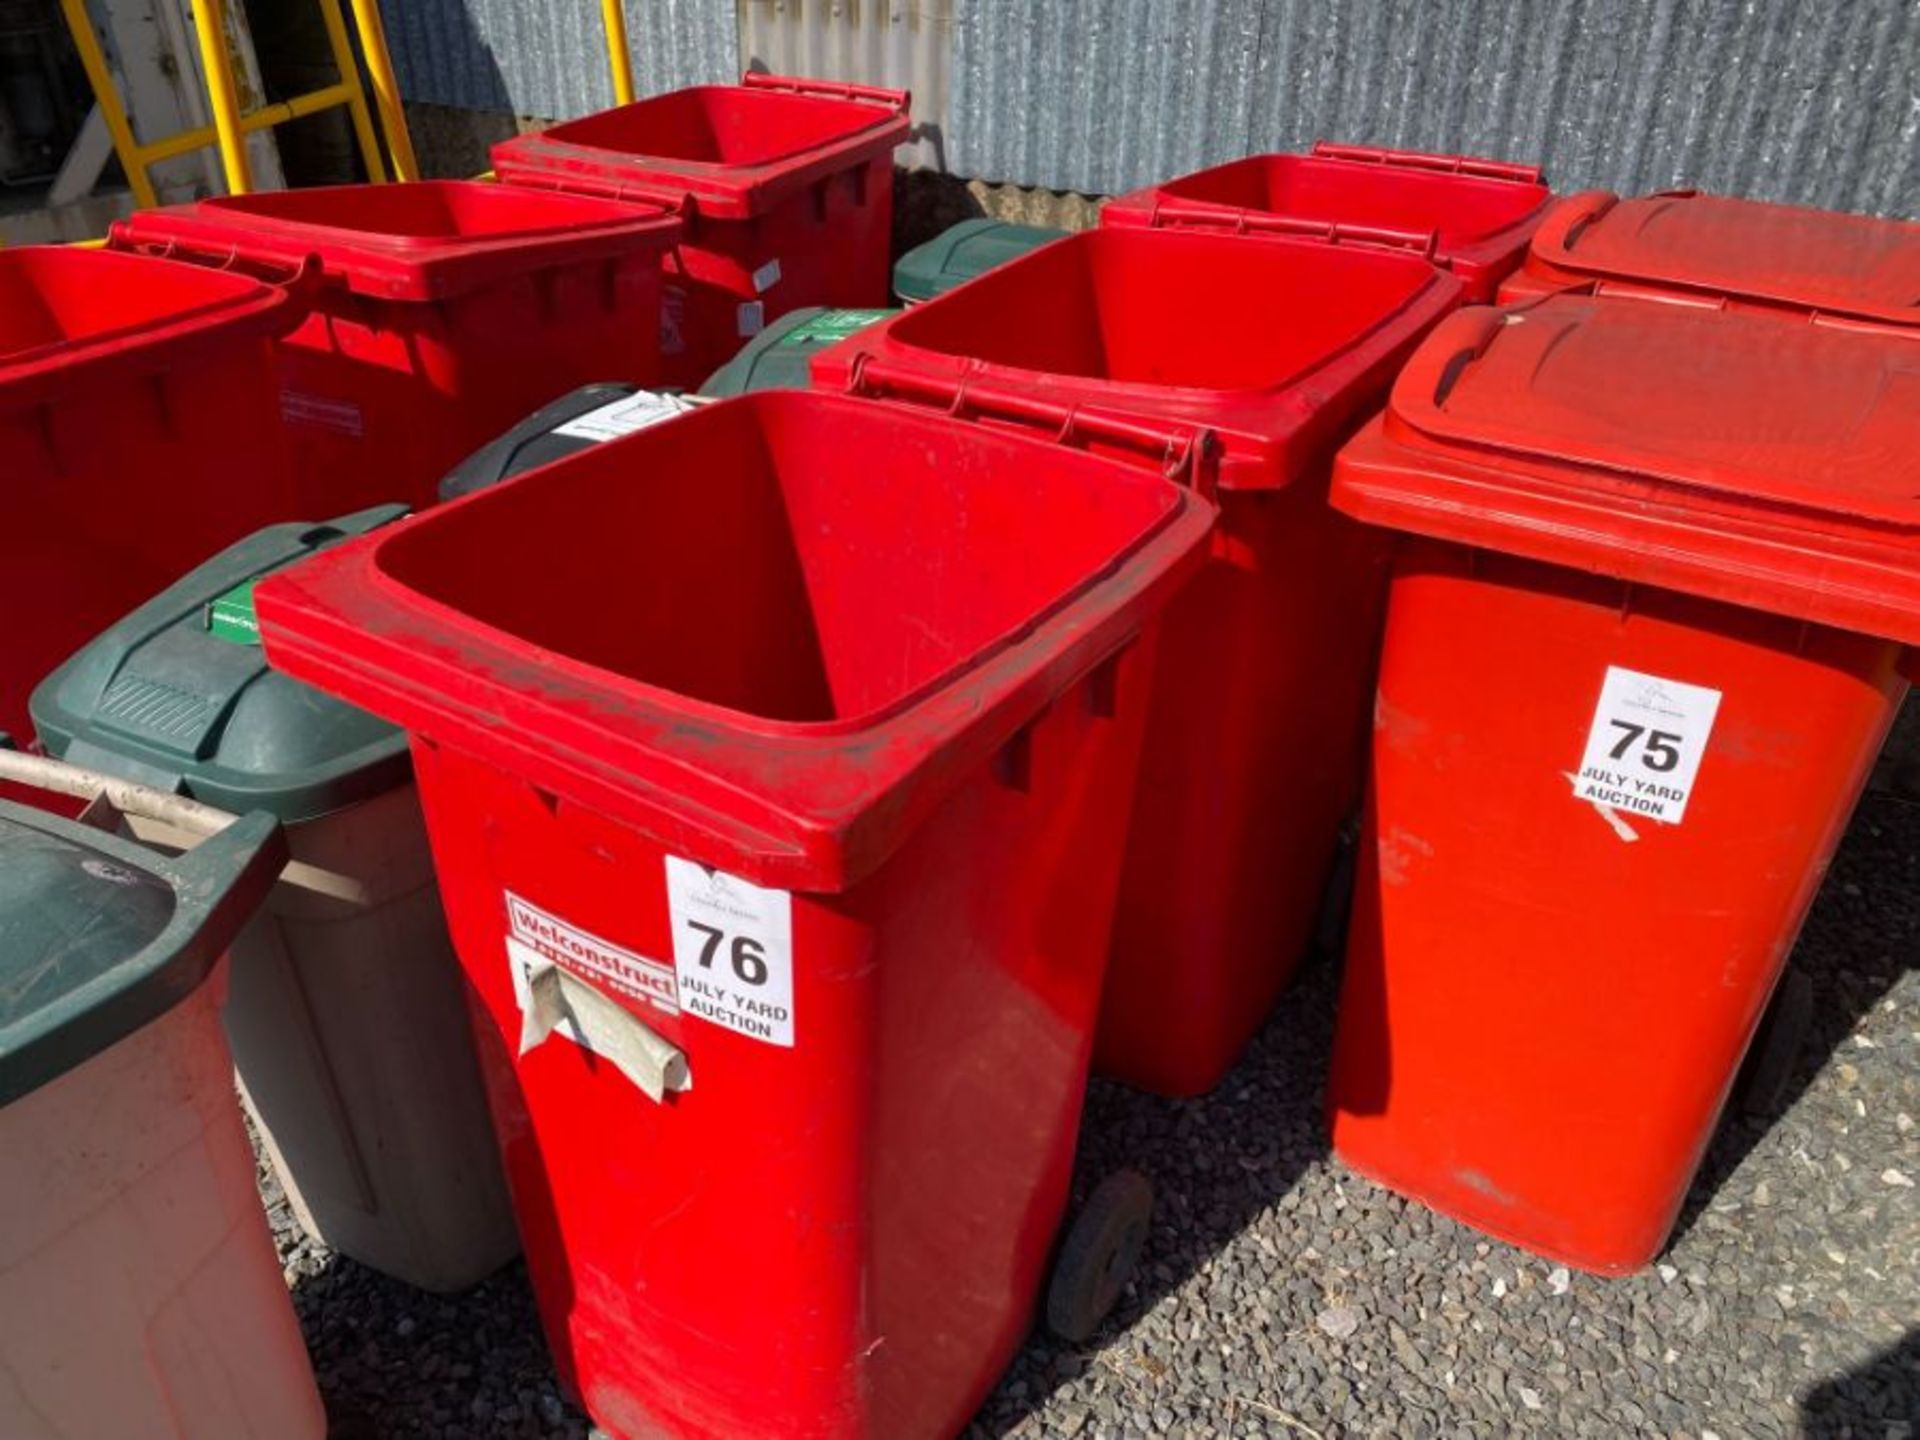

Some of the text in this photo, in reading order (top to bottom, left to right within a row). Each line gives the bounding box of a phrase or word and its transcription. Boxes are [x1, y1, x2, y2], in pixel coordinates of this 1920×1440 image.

[1610, 719, 1683, 772] 75
[1582, 767, 1684, 802] JULY YARD
[1585, 785, 1664, 815] AUCTION
[517, 909, 674, 997] Welconstruct
[688, 919, 768, 986] 76
[680, 975, 788, 1022] JULY YARD
[690, 997, 772, 1038] AUCTION
